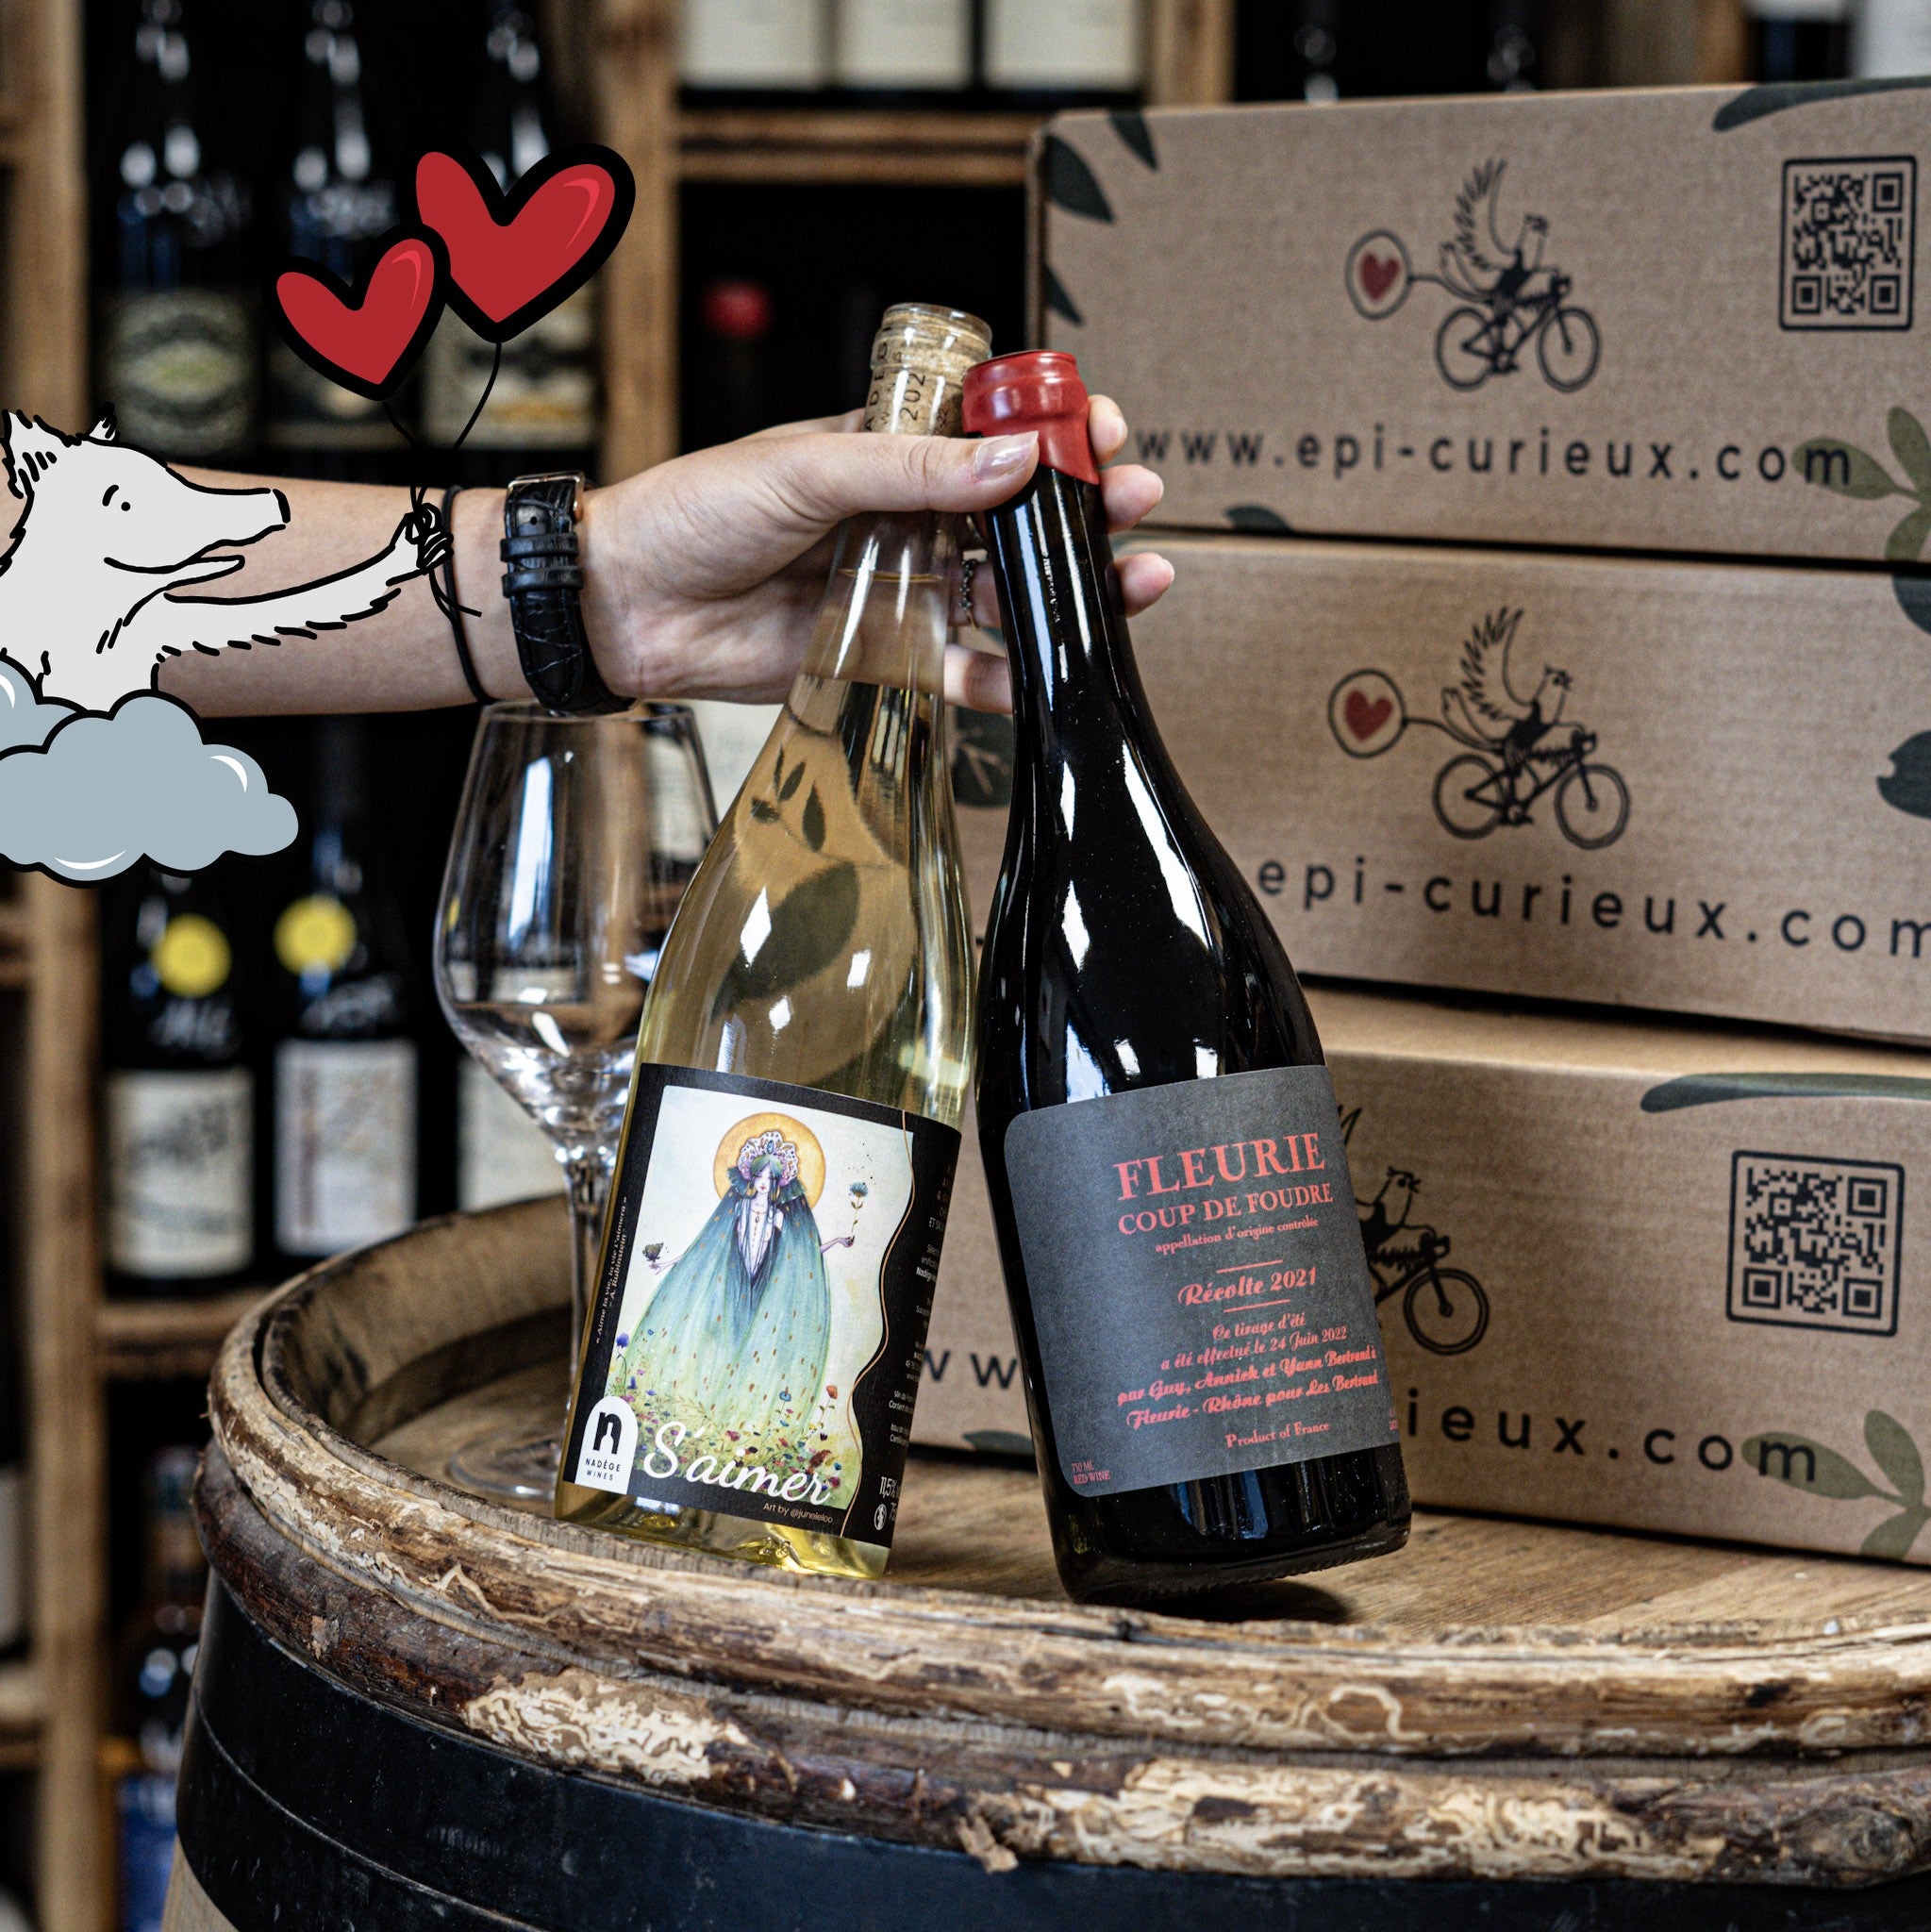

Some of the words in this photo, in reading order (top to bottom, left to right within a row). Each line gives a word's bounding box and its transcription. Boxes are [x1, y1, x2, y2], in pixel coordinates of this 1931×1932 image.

[1135, 424, 1851, 487] www.epi-curieux.com
[1112, 1132, 1325, 1201] FLEURIE
[1118, 1204, 1195, 1236] COUP
[1202, 1196, 1242, 1221] DE
[1245, 1183, 1334, 1214] FOUDRE
[1155, 1229, 1222, 1256] appellation
[1225, 1224, 1274, 1241] d'origine
[1177, 1275, 1265, 1306] Récolte
[1270, 1266, 1317, 1291] 2021
[1212, 1324, 1231, 1341] Ce
[1235, 1320, 1274, 1339] tirage
[1277, 1311, 1307, 1329] d'été
[1160, 1359, 1170, 1371] a
[1174, 1350, 1194, 1369] été
[1197, 1341, 1251, 1367] effectué
[1254, 1339, 1266, 1355] le
[1270, 1337, 1287, 1352] 24
[1289, 1331, 1319, 1352] Juin
[1321, 1325, 1348, 1343] 2022
[1117, 1390, 1144, 1407] par
[1148, 1379, 1191, 1401] Guy,
[1194, 1365, 1260, 1391] Annick
[1262, 1362, 1277, 1378] et
[1279, 1357, 1324, 1377] Yann
[1125, 1404, 1190, 1430] Fleurie
[1203, 1393, 1262, 1415] Rhône
[1265, 1387, 1304, 1407] pour
[1332, 1369, 1378, 1391] Bertrand
[1224, 1428, 1277, 1449] Product
[1279, 1424, 1291, 1439] of
[1293, 1422, 1330, 1438] France
[585, 1457, 622, 1473] NADÈGE
[587, 1469, 614, 1481] WINES
[643, 1421, 831, 1506] S'aimer
[1073, 1473, 1089, 1485] RED
[1089, 1470, 1111, 1483] WINE
[1083, 1459, 1094, 1472] ML
[762, 1502, 777, 1512] Art
[777, 1504, 790, 1516] by
